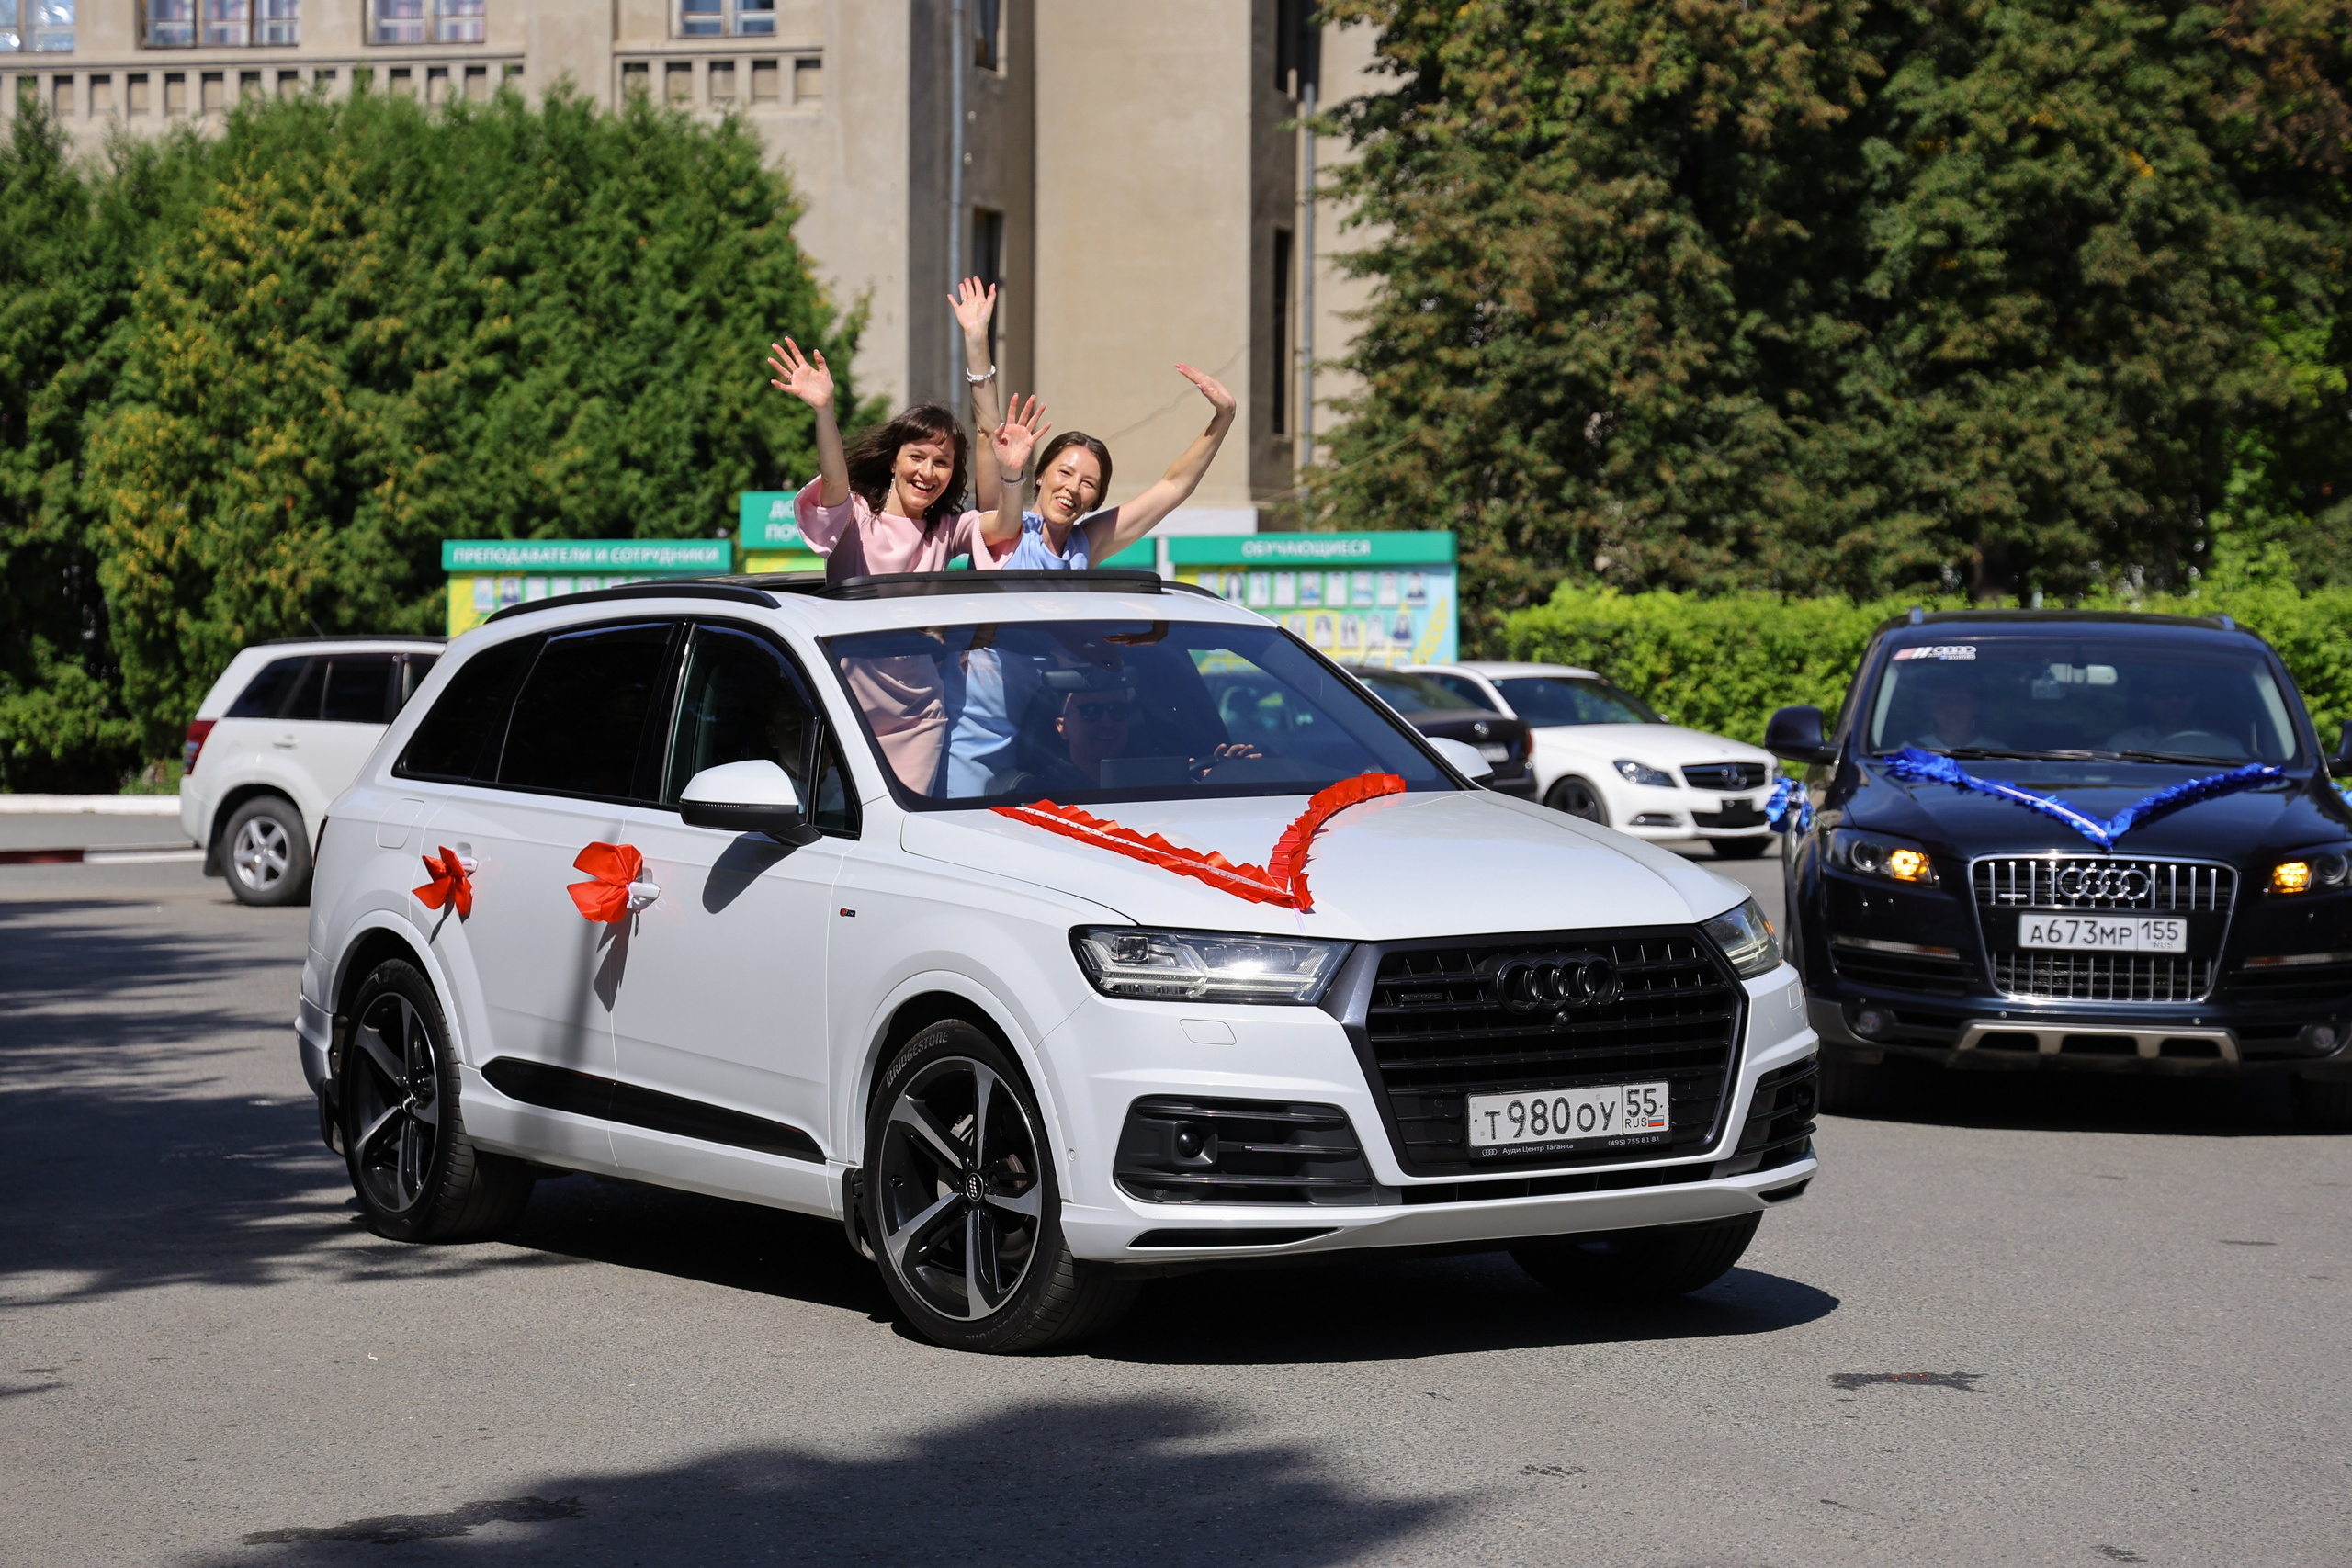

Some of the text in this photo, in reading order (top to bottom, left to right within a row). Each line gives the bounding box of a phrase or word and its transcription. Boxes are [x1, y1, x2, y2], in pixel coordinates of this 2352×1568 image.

[453, 547, 719, 566] ПРЕПОДАВАТЕЛИ И СОТРУДНИКИ
[1241, 539, 1371, 559] ОБУЧАЮЩИЕСЯ
[2030, 919, 2133, 946] А673МР
[2140, 920, 2179, 941] 155
[885, 1031, 950, 1089] BRIDGESTONE
[1625, 1088, 1657, 1118] 55
[1484, 1096, 1617, 1140] Т980ОУ
[1624, 1117, 1648, 1129] RUS
[1502, 1147, 1521, 1156] Ауди
[1545, 1143, 1574, 1151] Таганка
